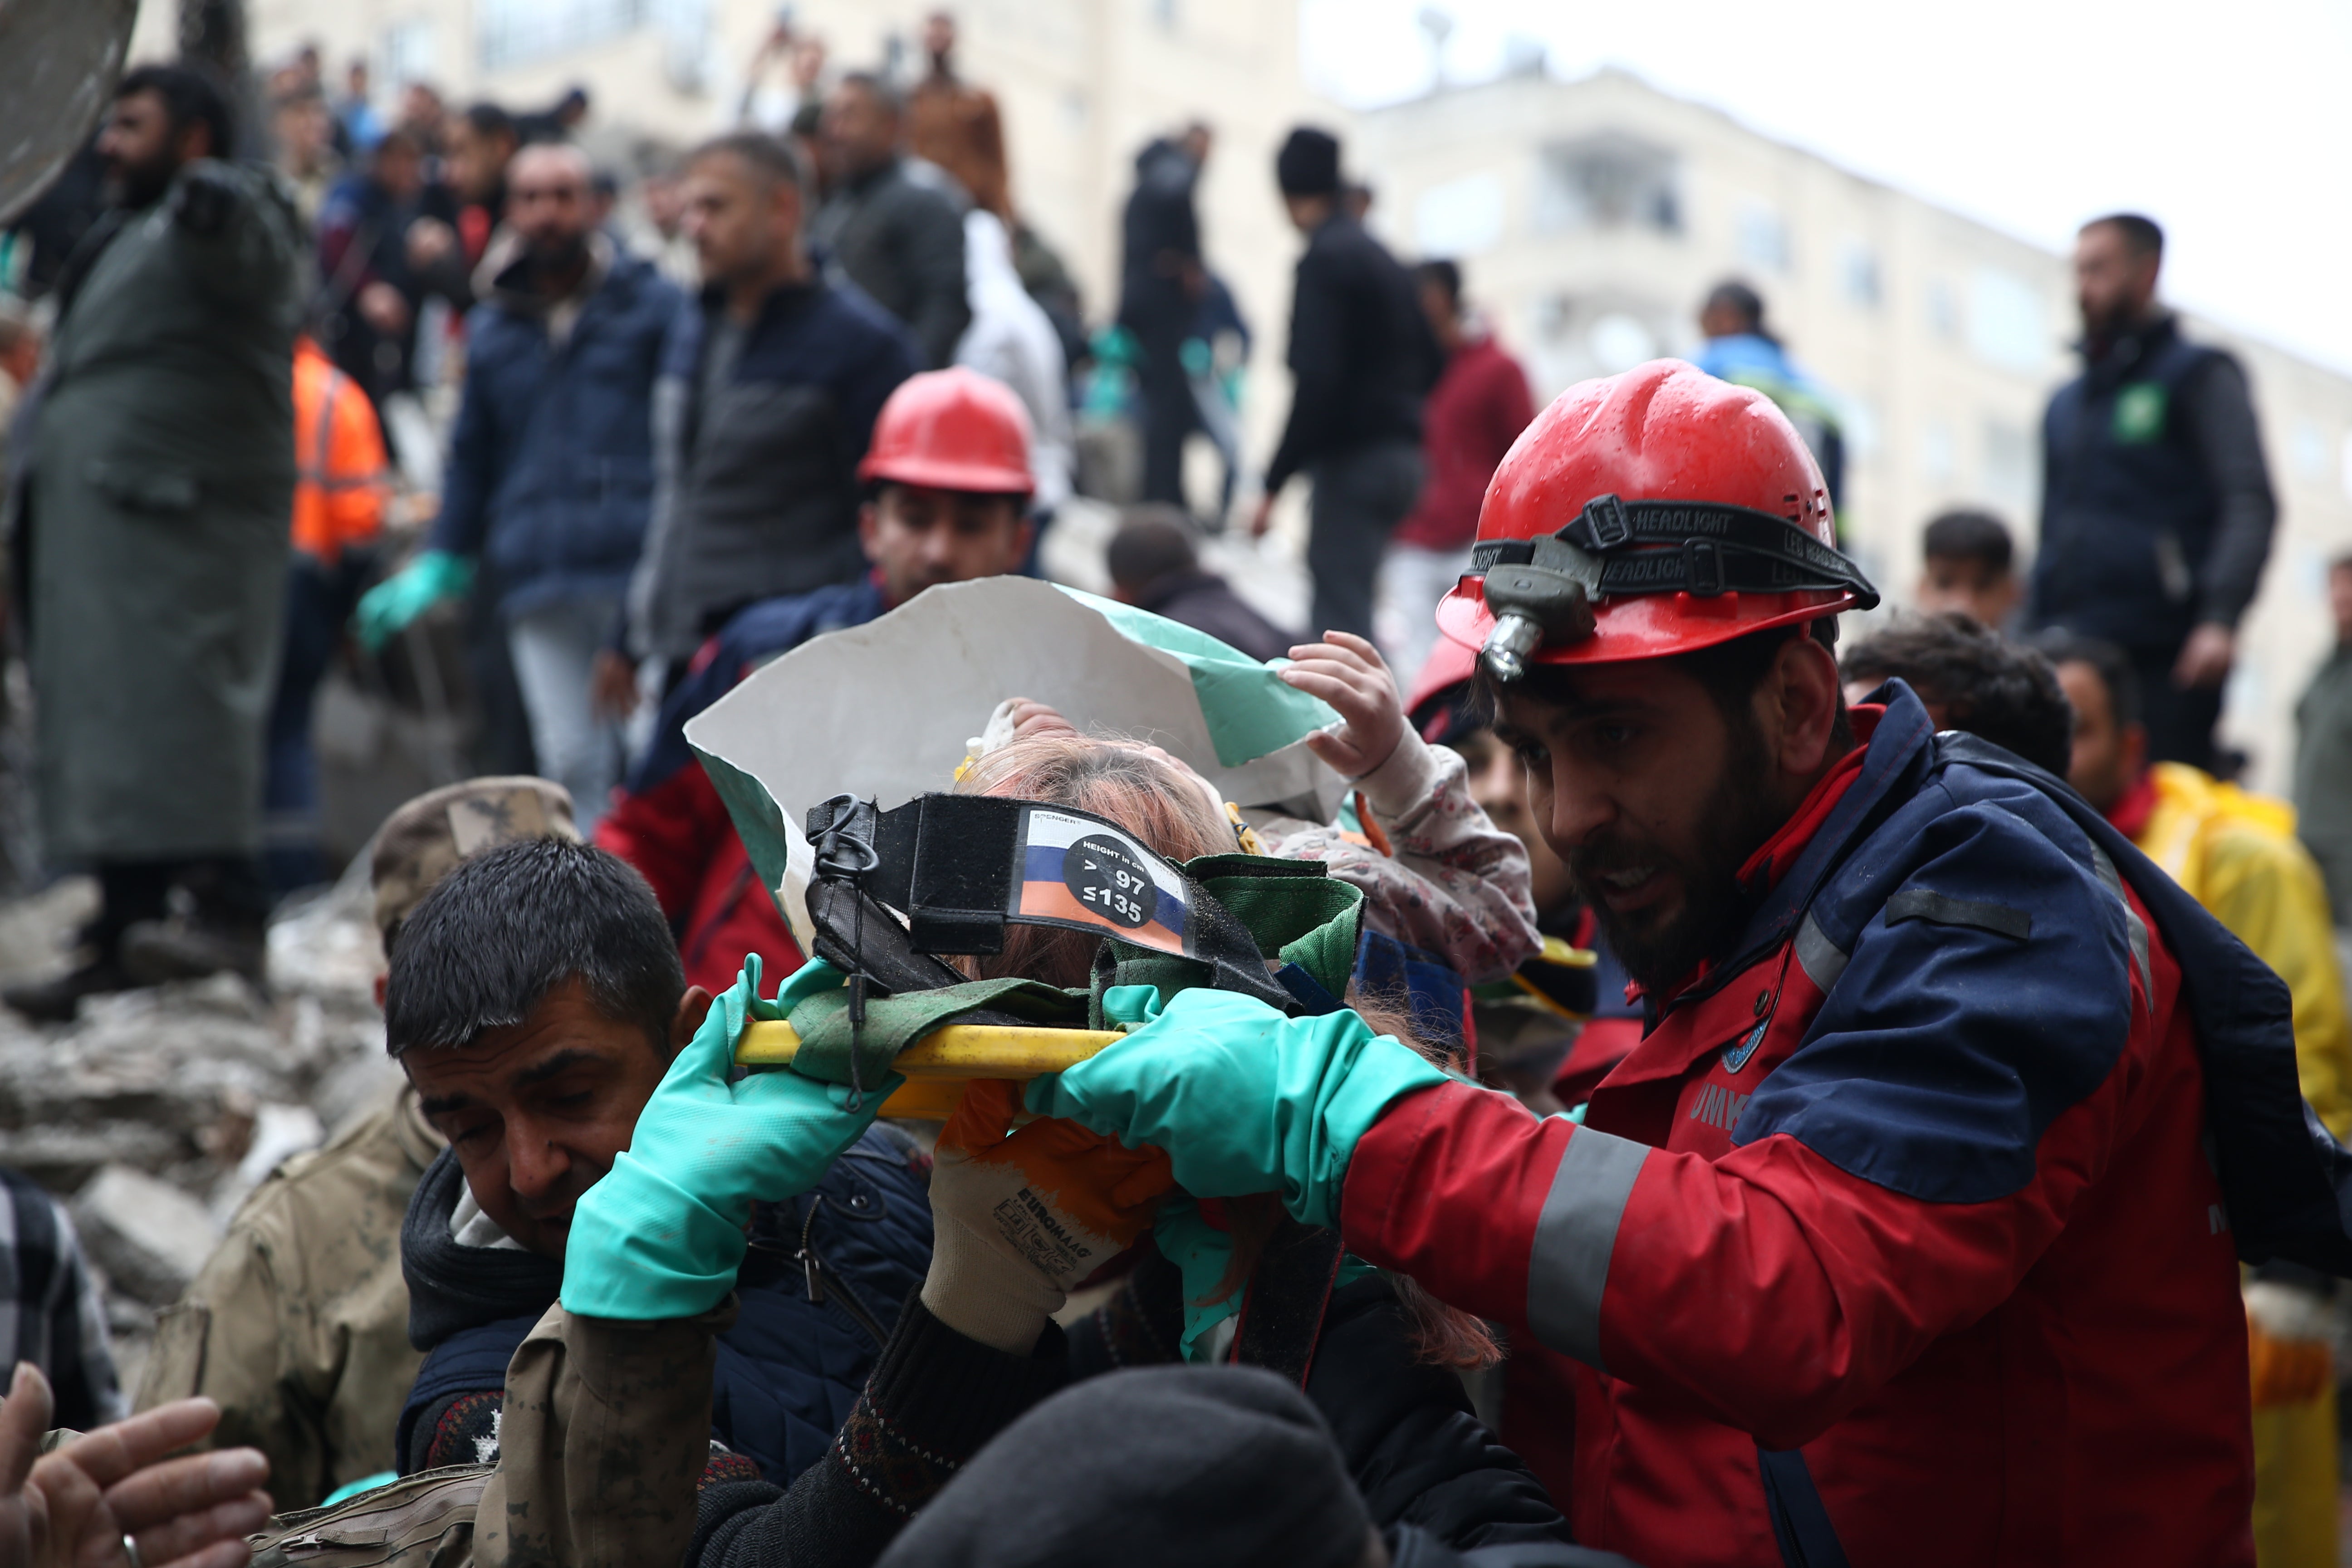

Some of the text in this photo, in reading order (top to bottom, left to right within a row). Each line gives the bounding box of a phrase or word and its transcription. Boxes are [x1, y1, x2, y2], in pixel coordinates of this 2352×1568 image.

[1636, 508, 1734, 535] HEADLIGHT
[1602, 556, 1686, 582] EADLIGH
[1083, 841, 1120, 859] HEIGHT
[1122, 855, 1131, 864] in
[1132, 861, 1145, 872] cm
[1116, 869, 1145, 895] 97
[1690, 1082, 1752, 1131] UMK
[1017, 1187, 1090, 1258] EUROMAAG
[1026, 1254, 1051, 1276] TURKEY
[1055, 1244, 1077, 1264] SIZE 10
